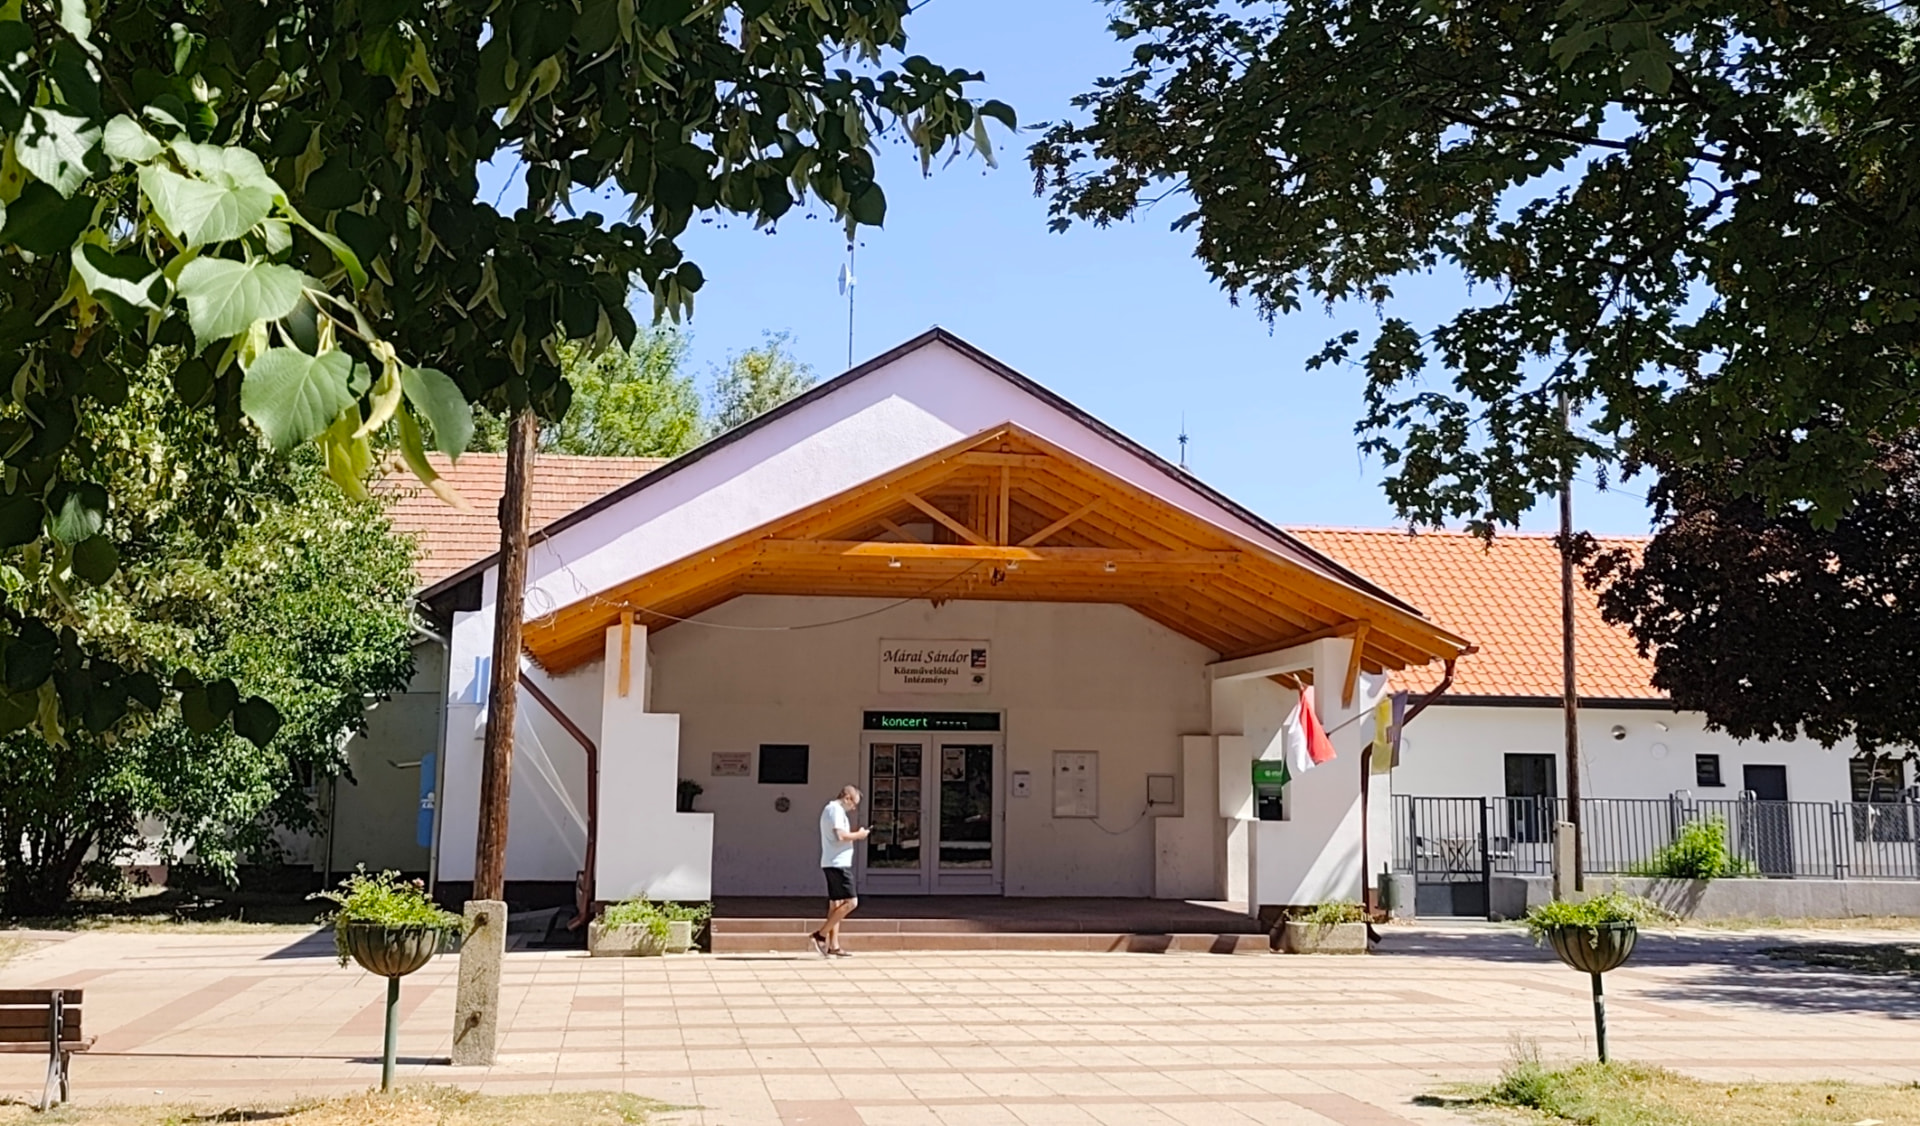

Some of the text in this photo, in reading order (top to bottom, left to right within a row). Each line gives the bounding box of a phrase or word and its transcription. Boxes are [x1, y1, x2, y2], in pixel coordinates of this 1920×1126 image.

[883, 648, 969, 664] Márai Sándor
[904, 676, 948, 685] Intézmény
[882, 716, 928, 727] koncert
